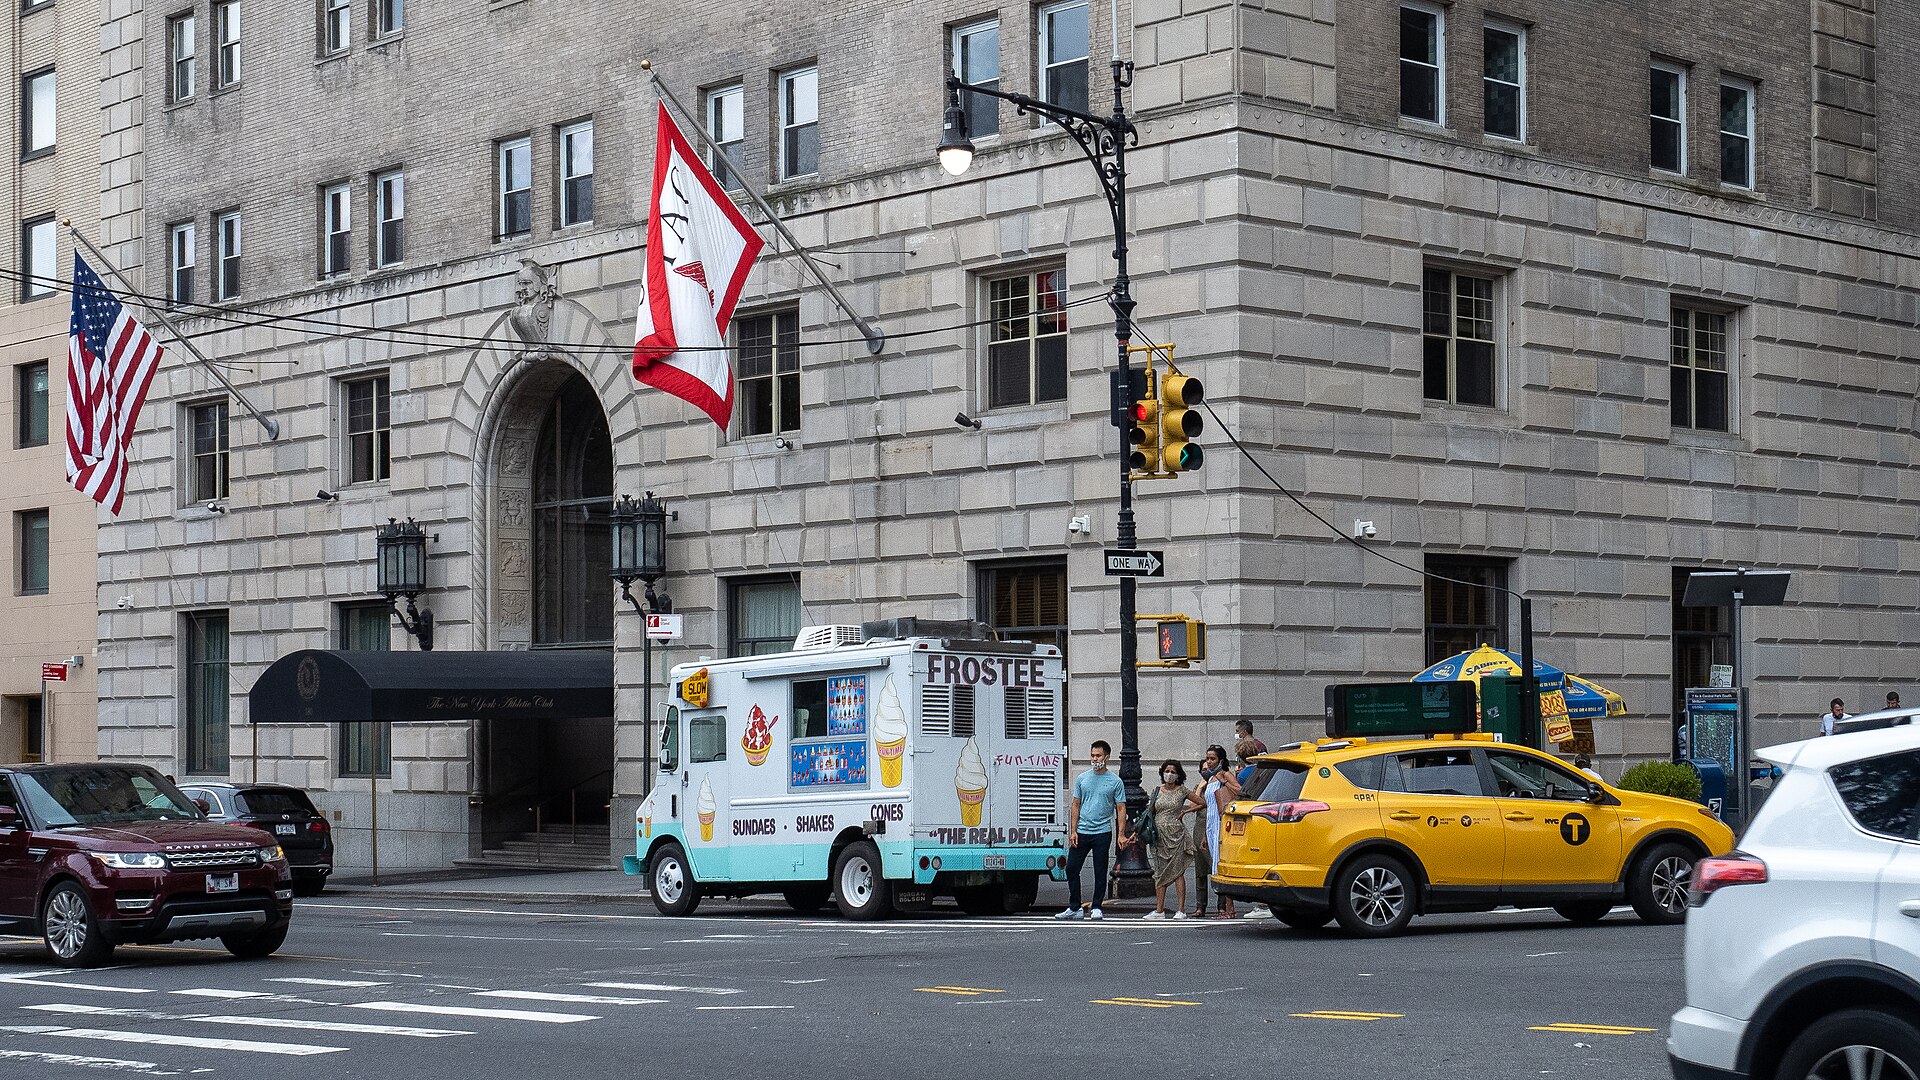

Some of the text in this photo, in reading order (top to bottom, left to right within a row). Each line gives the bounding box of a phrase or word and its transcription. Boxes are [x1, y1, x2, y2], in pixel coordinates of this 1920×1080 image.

[1113, 557, 1156, 569] ONE WAY
[927, 654, 1045, 687] FROSTEE
[688, 681, 707, 695] SLOW
[426, 695, 554, 712] The New York Athletic Club
[870, 803, 904, 821] CONES
[732, 814, 835, 836] SUNDAES SHAKES
[1566, 819, 1584, 842] T
[968, 827, 1007, 845] REAL
